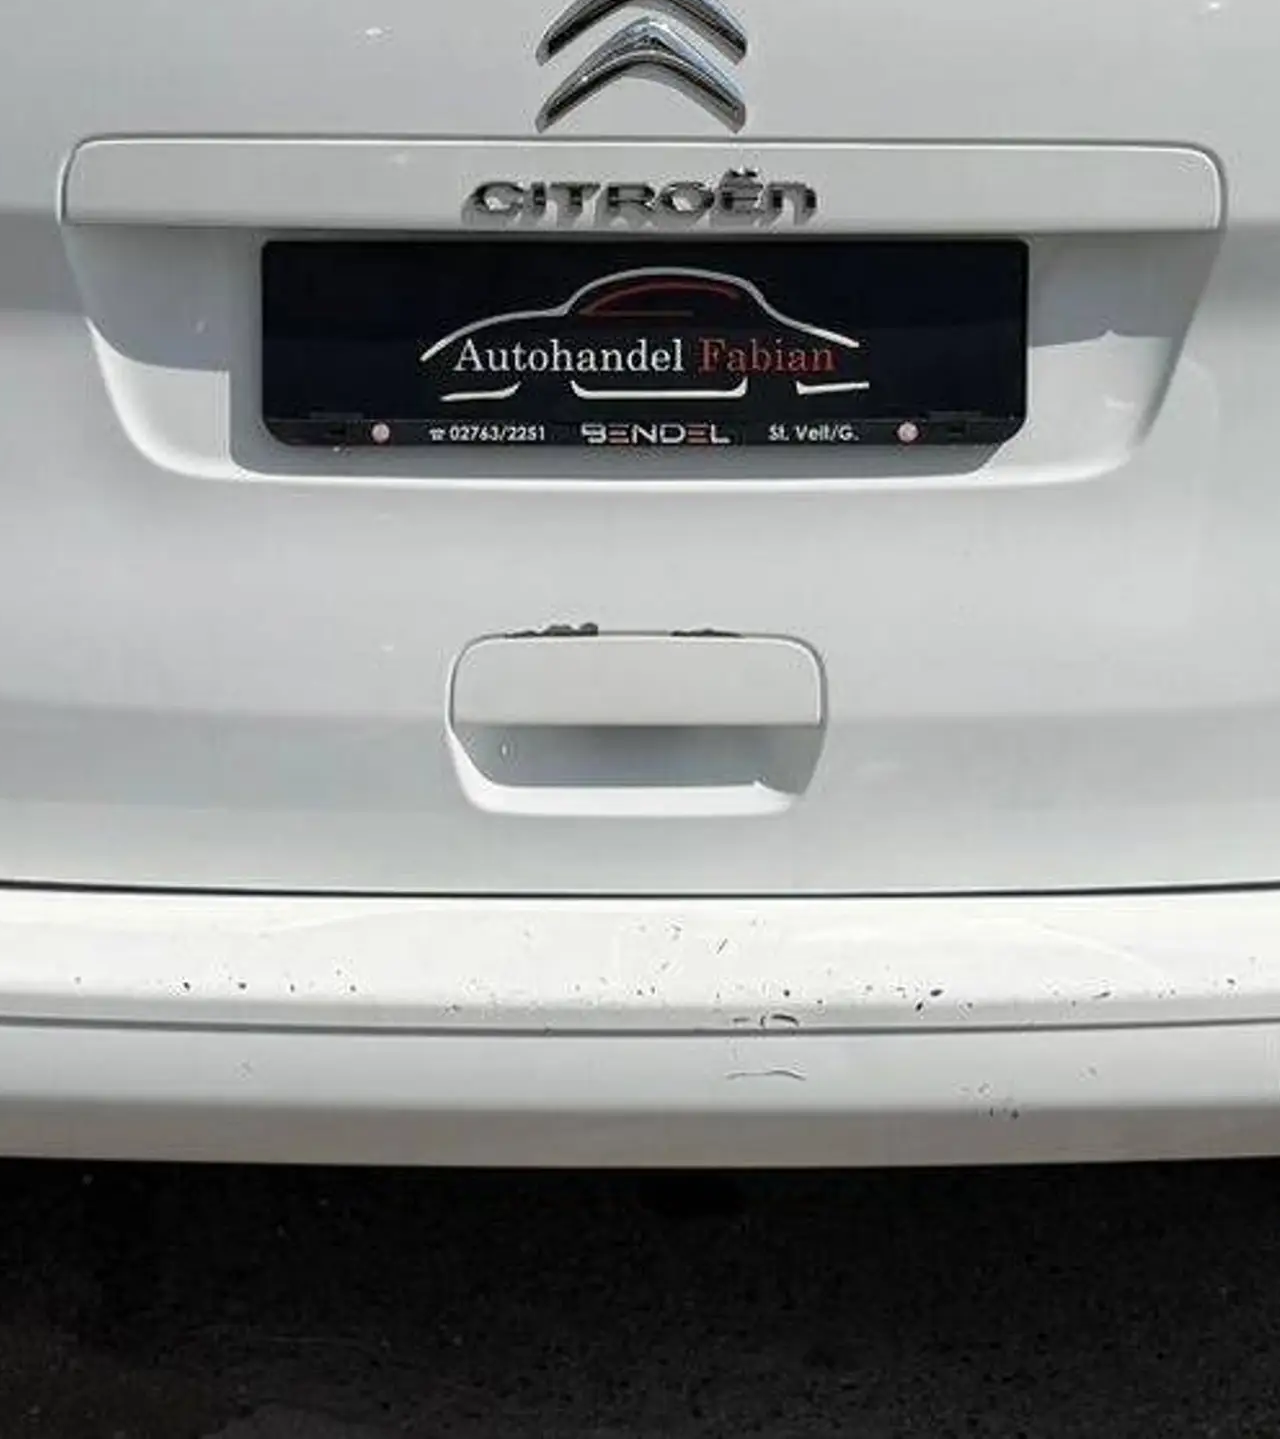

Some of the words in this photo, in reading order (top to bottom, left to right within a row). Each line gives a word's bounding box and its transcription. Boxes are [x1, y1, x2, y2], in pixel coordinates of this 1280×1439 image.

[453, 338, 685, 373] Autohandel
[698, 339, 838, 373] Fabian
[449, 424, 546, 442] 02763/2251
